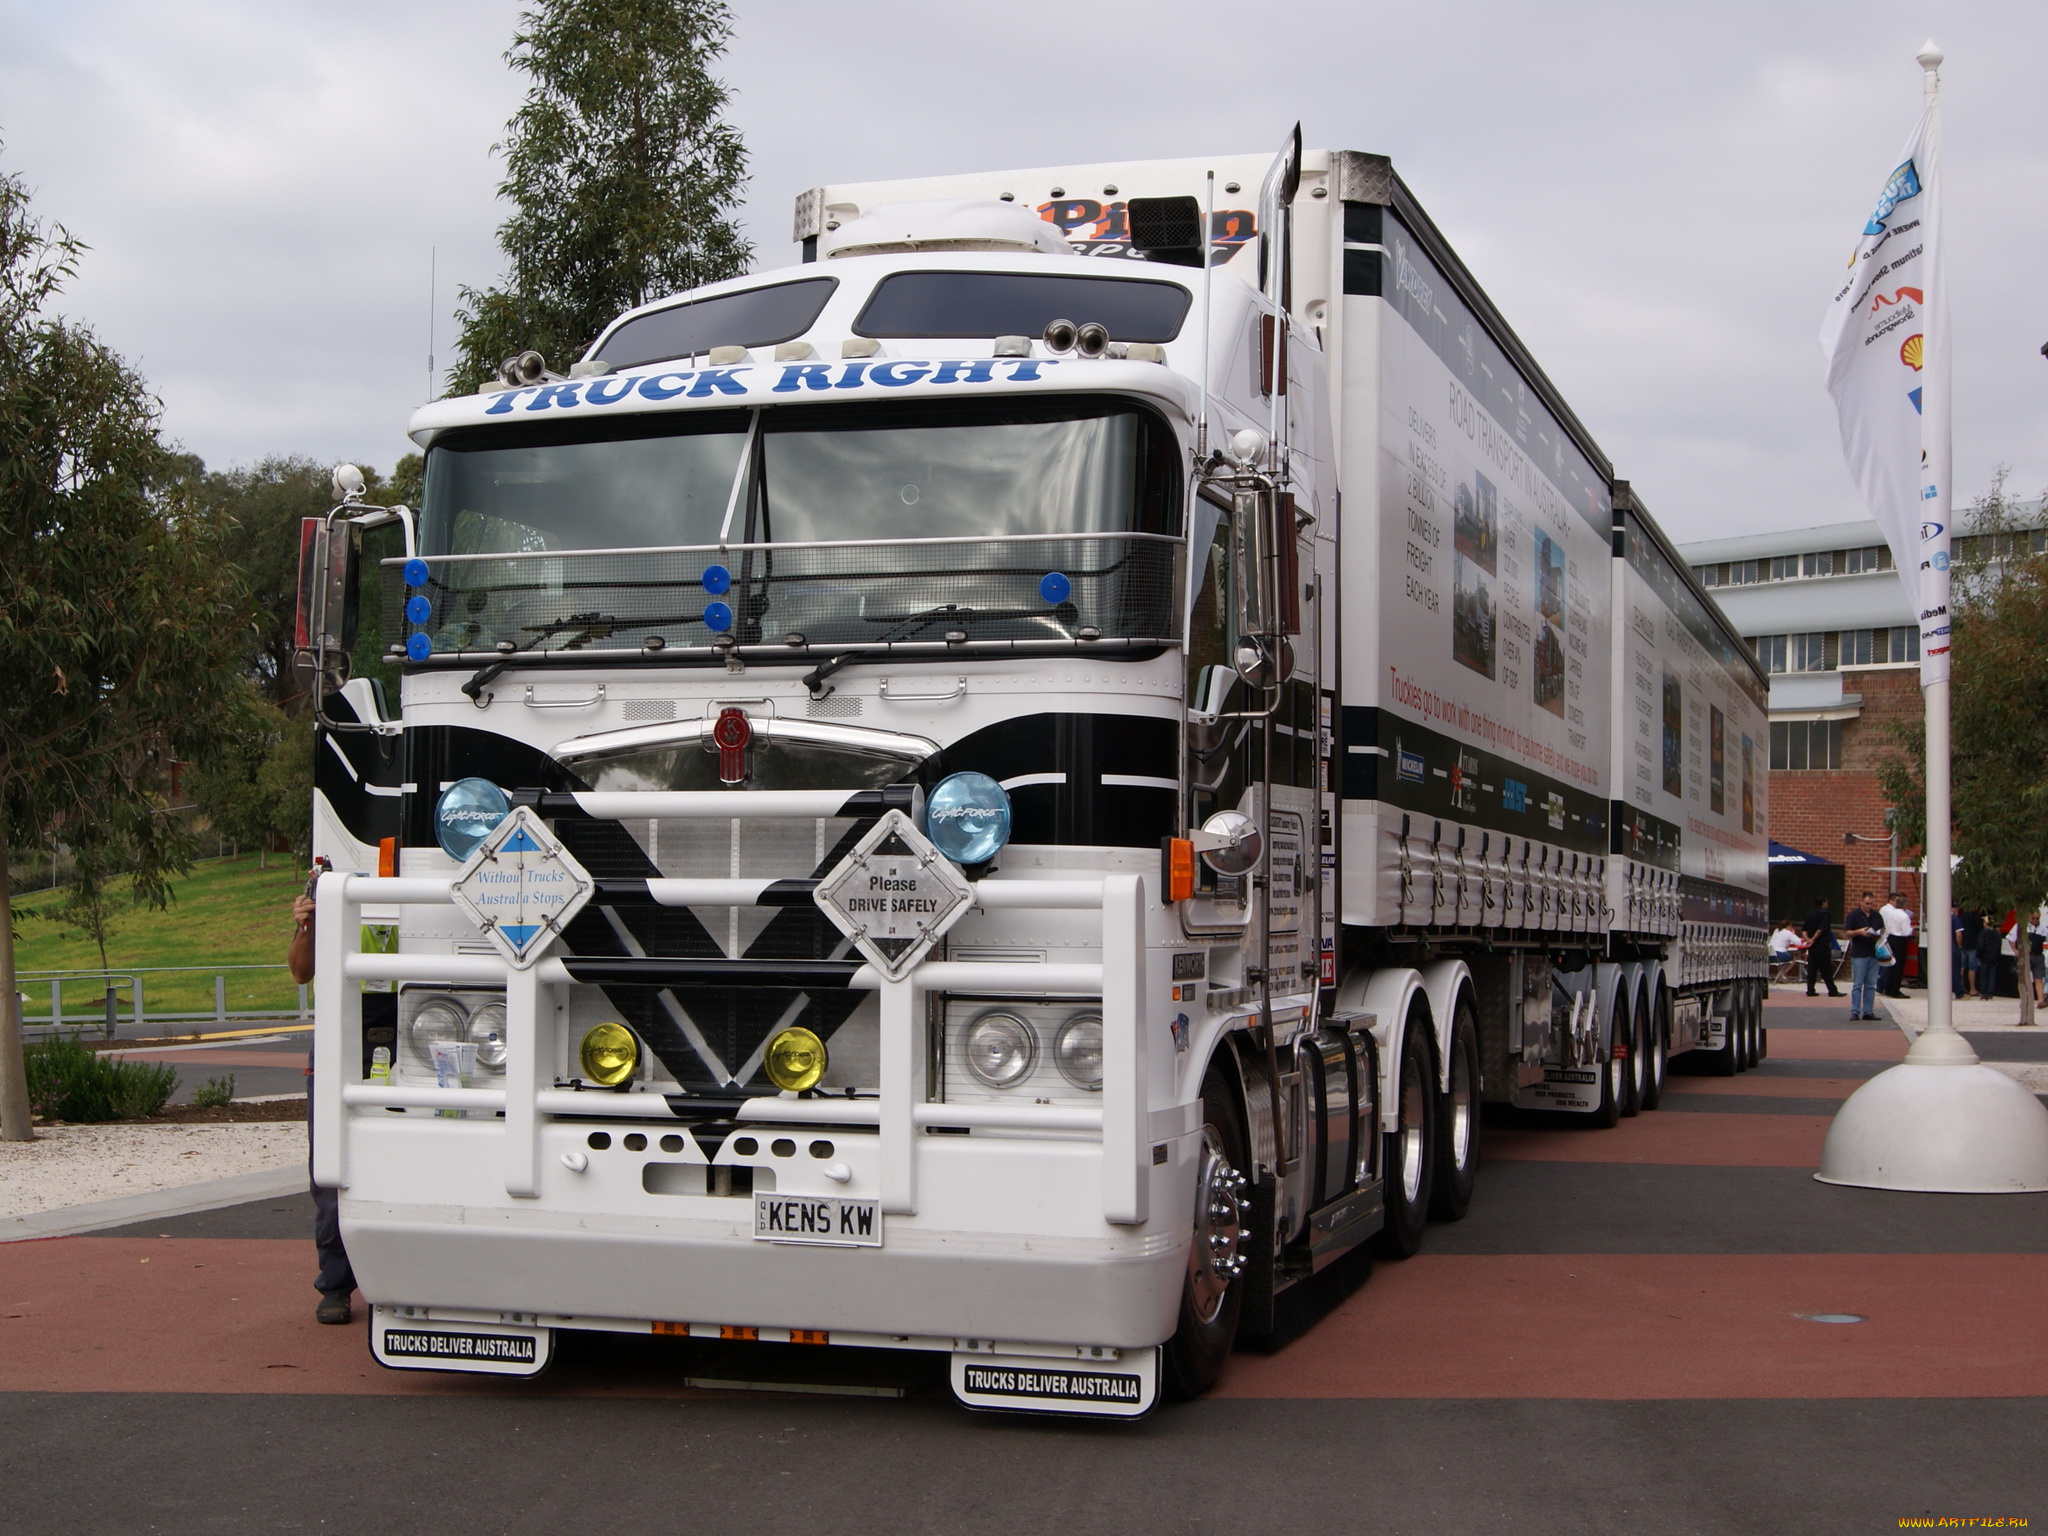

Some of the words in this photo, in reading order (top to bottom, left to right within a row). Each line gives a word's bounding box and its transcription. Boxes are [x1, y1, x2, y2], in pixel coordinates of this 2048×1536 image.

[484, 367, 753, 415] TRUCK
[771, 359, 1060, 394] RIGHT
[1408, 405, 1437, 450] DELIVERS
[1449, 380, 1475, 441] ROAD
[1476, 409, 1524, 491] TRANSPORT
[1407, 506, 1431, 543] TONNES
[1432, 527, 1440, 548] OF
[1406, 540, 1433, 576] FREIGHT
[1406, 574, 1423, 605] EACH
[1423, 585, 1440, 615] YEAR
[1390, 666, 1422, 711] Truckies
[1423, 691, 1432, 721] go
[1434, 692, 1441, 719] to
[1442, 697, 1457, 727] work
[1458, 701, 1470, 732] with
[1471, 713, 1481, 736] one
[1402, 757, 1424, 775] MICHELIN
[477, 870, 523, 884] Withou
[527, 869, 564, 883] Trucks
[870, 876, 917, 892] Please
[477, 891, 529, 905] Australa
[849, 898, 887, 912] DRIVE
[891, 898, 938, 913] SAFELY
[1564, 1072, 1595, 1082] AUSTRALIA
[769, 1201, 831, 1234] KENS
[840, 1205, 873, 1236] KW
[387, 1334, 428, 1353] TRUCKS
[430, 1336, 473, 1356] DELIVER
[474, 1338, 533, 1359] AUSTRALIA
[968, 1369, 1015, 1391] TRUCKS
[1017, 1373, 1068, 1394] DELIVER
[1070, 1376, 1138, 1399] AUSTRALIA
